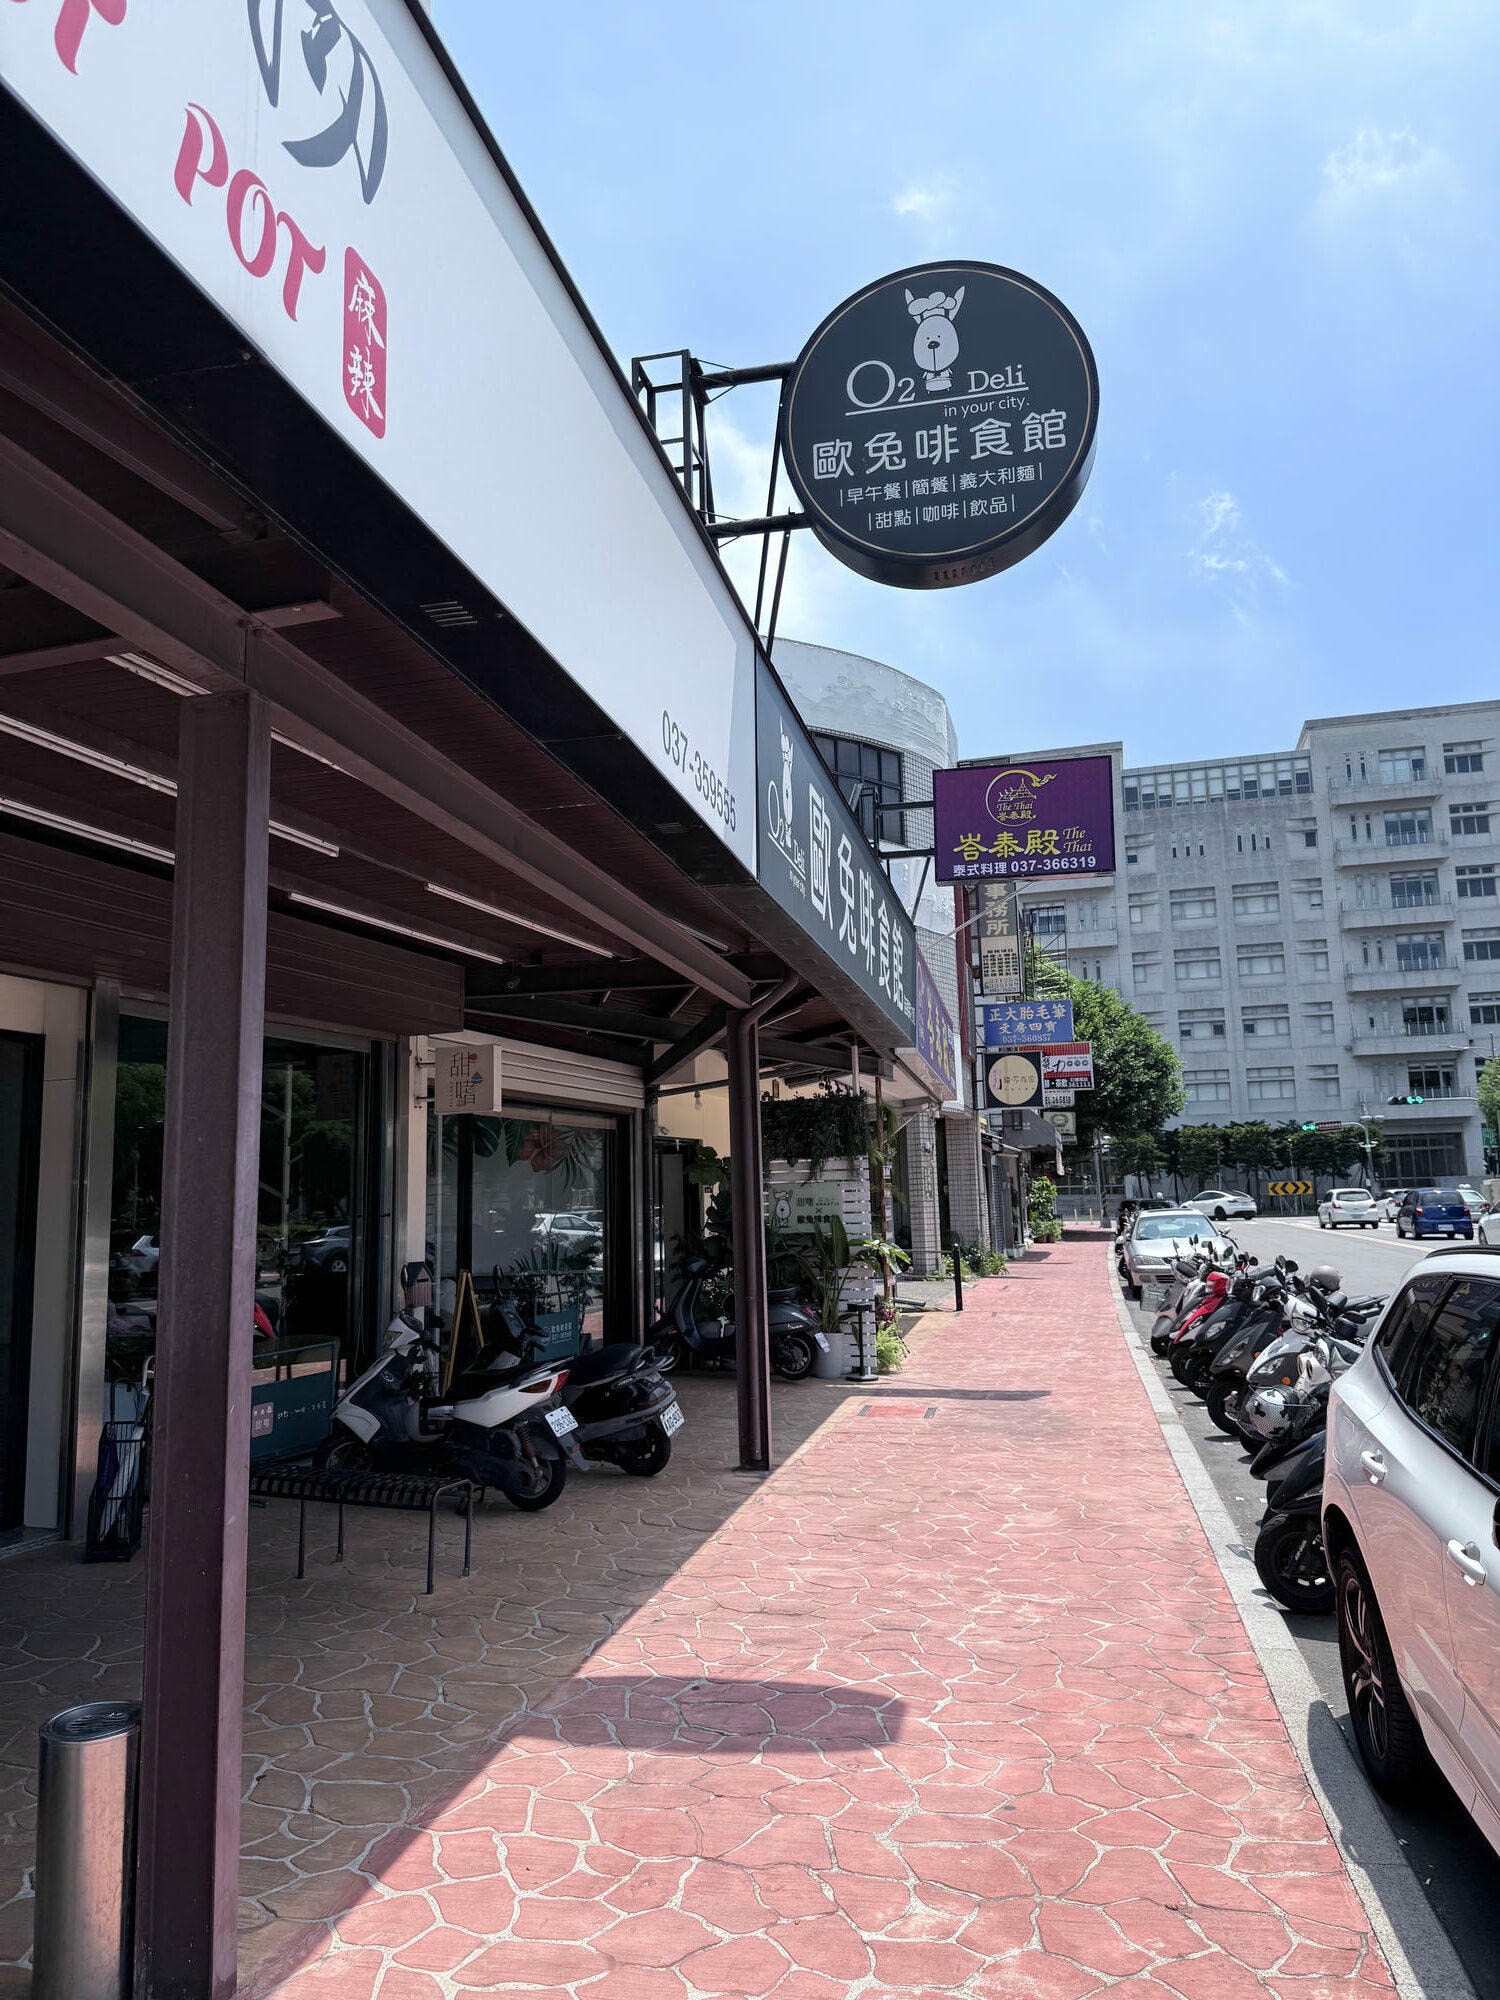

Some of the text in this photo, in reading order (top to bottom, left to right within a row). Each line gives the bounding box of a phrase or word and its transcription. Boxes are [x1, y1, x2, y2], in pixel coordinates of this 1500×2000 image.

[174, 102, 326, 322] POT
[348, 269, 386, 420] 麻辣
[967, 364, 1026, 393] Deli
[944, 396, 1030, 419] in your city.
[812, 408, 1067, 481] 歐兔啡食館
[662, 709, 736, 833] 037-359555
[997, 801, 1033, 811] The Thai
[1063, 826, 1086, 840] The
[1063, 840, 1092, 853] Thai
[953, 855, 1097, 877] 泰式料理 037-366319
[809, 783, 904, 1012] 歐兔啡食館
[989, 1004, 1067, 1022] 正大胎毛筆
